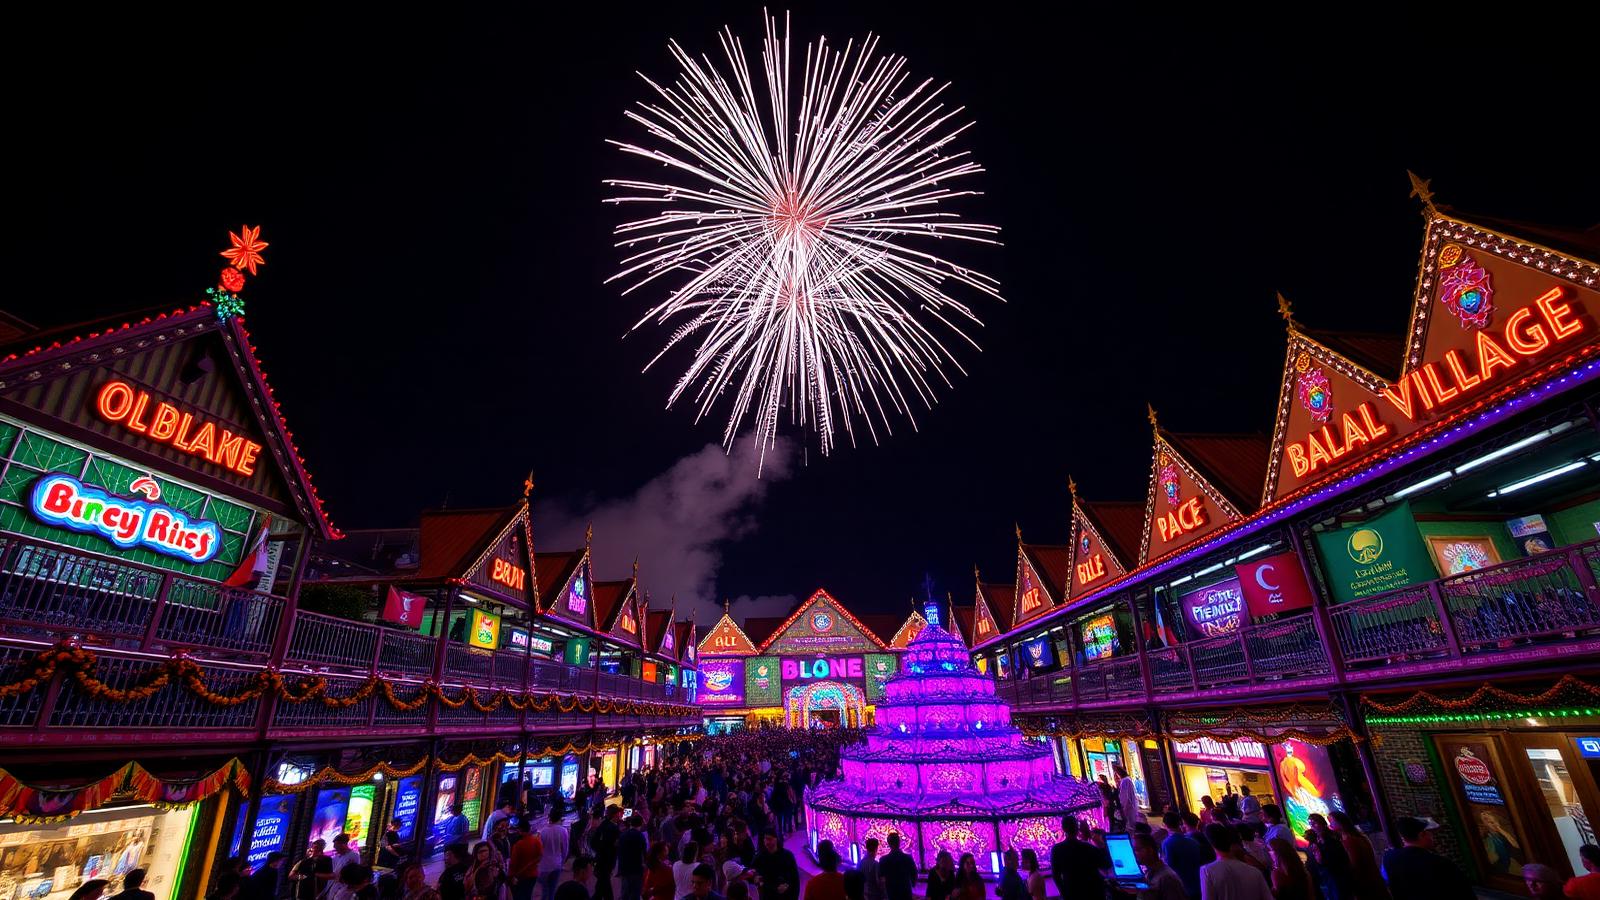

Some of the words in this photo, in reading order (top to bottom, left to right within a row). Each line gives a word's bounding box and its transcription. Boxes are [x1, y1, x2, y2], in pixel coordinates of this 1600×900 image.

[1286, 401, 1389, 479] BALAL
[1382, 286, 1585, 420] VILLAGE
[1157, 496, 1205, 542] PACE
[782, 657, 863, 680] BLONE
